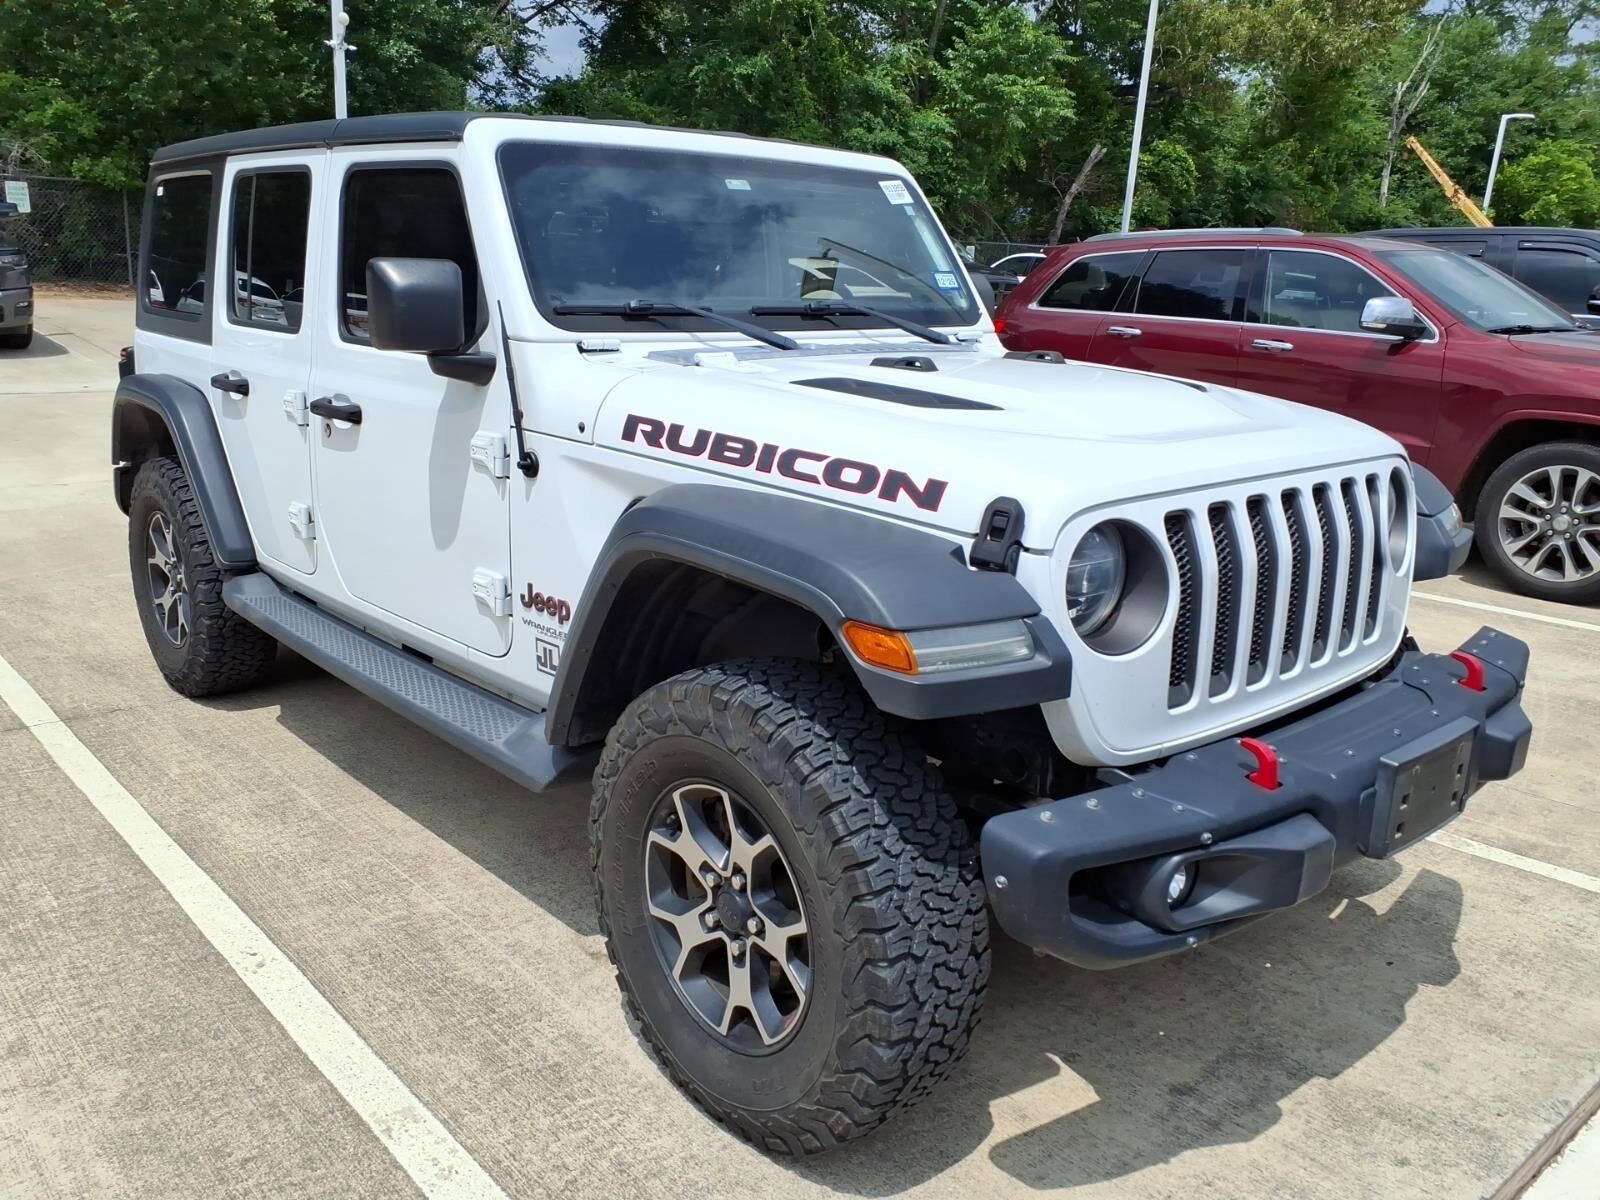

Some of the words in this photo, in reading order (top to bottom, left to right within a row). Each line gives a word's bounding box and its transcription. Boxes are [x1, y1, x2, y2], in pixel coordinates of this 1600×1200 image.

[620, 413, 949, 513] RUBICON
[519, 582, 571, 625] Jeep
[537, 646, 559, 671] JL
